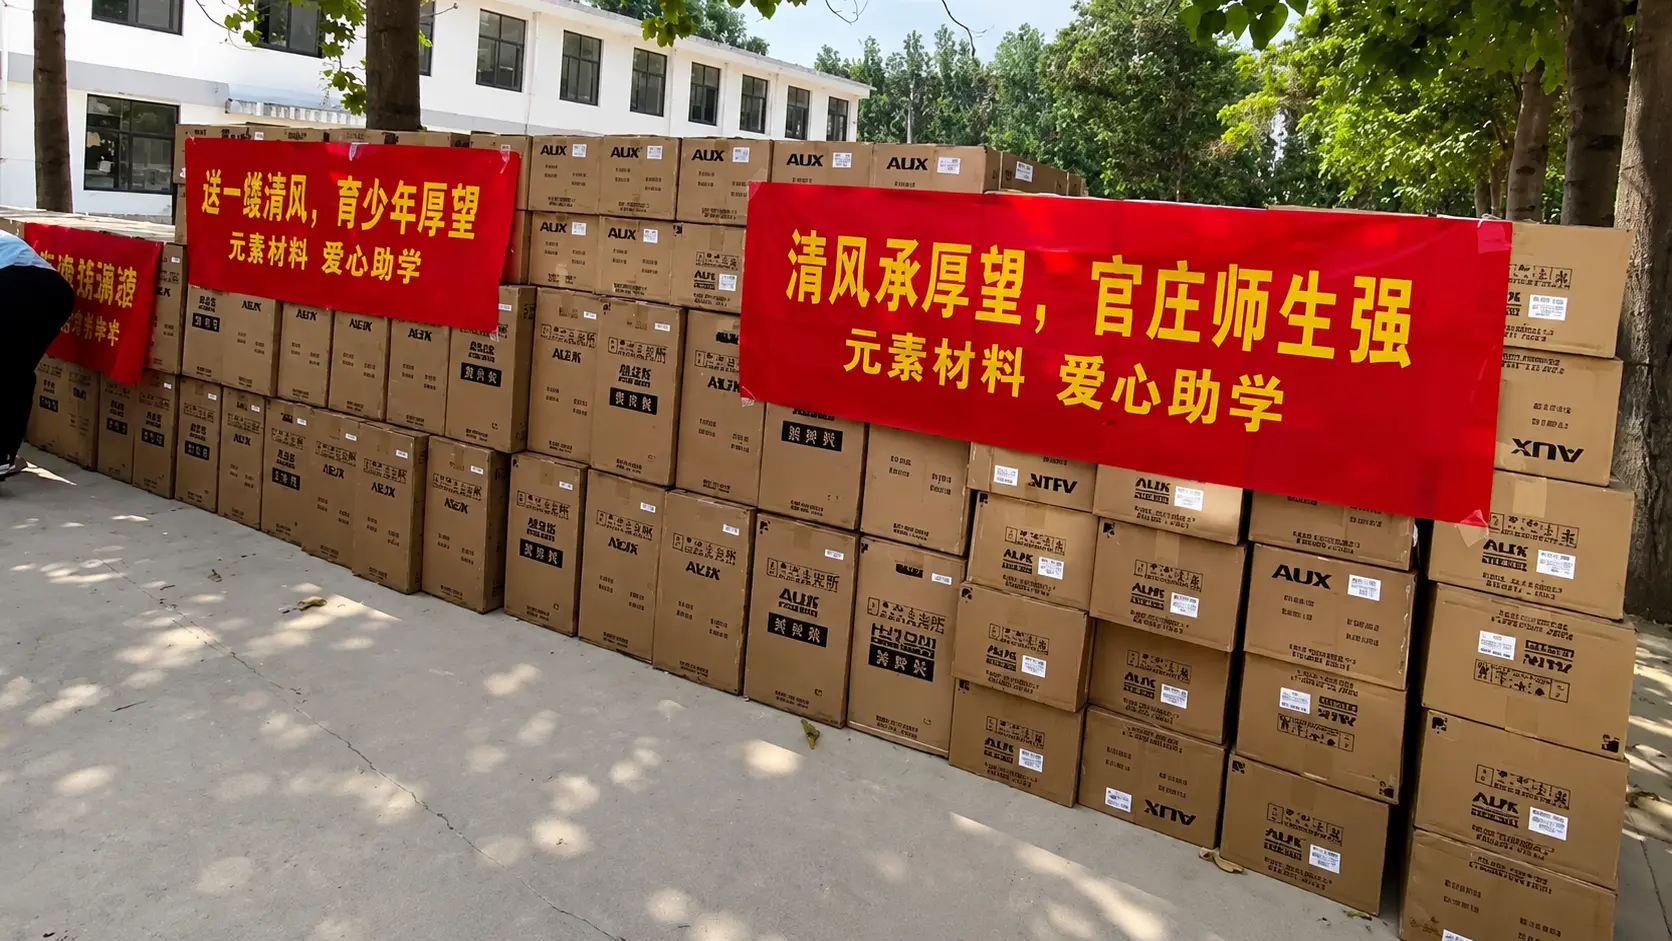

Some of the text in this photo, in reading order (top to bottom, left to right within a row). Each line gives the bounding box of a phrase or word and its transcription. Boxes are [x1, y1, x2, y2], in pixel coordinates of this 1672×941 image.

[540, 144, 567, 156] AUX
[610, 146, 640, 159] AUX
[691, 149, 725, 162] AUX
[786, 153, 823, 168] AUX
[886, 157, 929, 171] AUX
[337, 175, 481, 240] 育少年厚望
[539, 221, 567, 234] AUX
[607, 227, 637, 241] AUX
[228, 231, 422, 284] 元素材料 爱心助学
[785, 228, 1413, 369] 清风承厚望， 官庄师生强
[843, 328, 1284, 433] 元素材料 爱心助学
[1510, 437, 1585, 464] AUX
[1271, 563, 1332, 590] AUX
